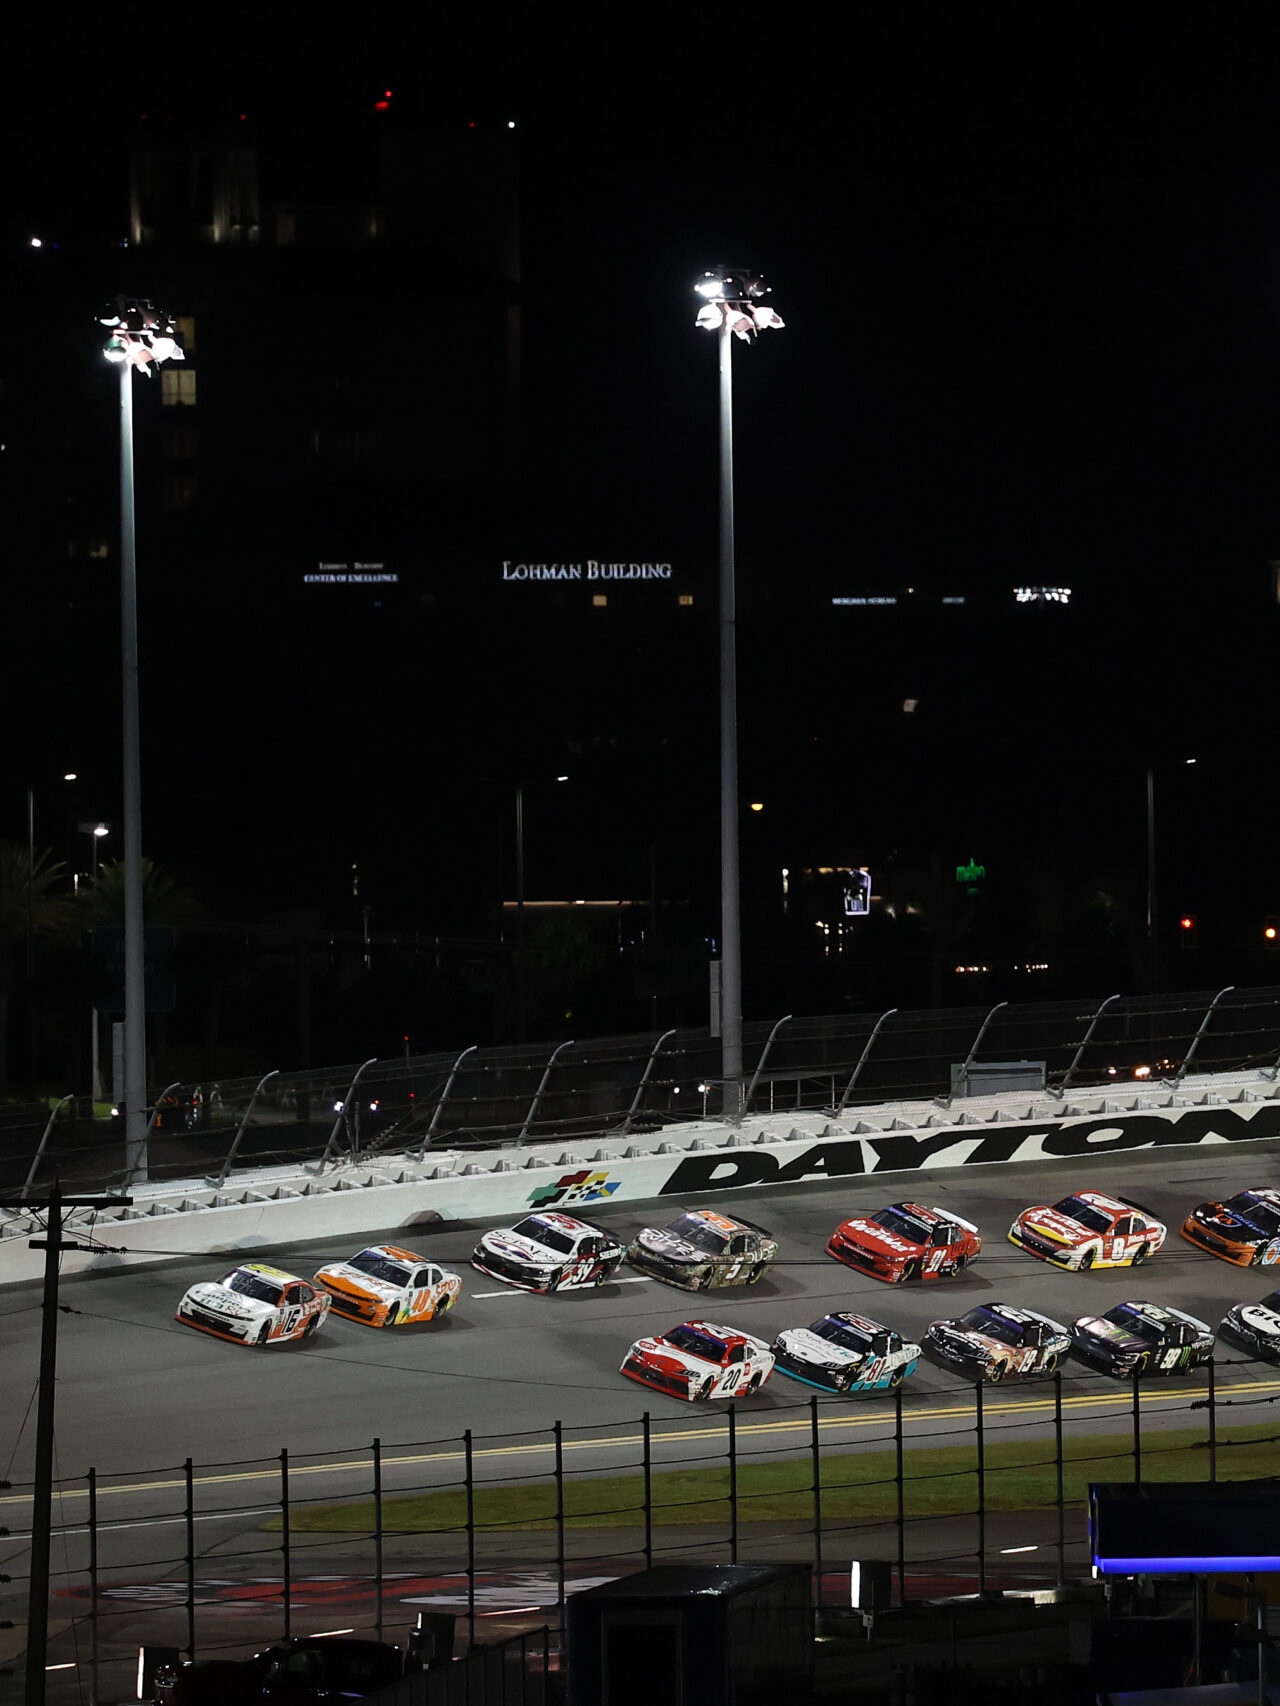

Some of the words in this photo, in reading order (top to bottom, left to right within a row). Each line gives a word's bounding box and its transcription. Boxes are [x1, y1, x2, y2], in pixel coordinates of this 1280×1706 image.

[502, 560, 581, 581] LOHMAN
[587, 560, 672, 580] BUILDING
[698, 1210, 738, 1231] 5
[925, 1249, 947, 1273] 91
[1111, 1238, 1126, 1260] 8
[572, 1256, 595, 1284] 39
[725, 1256, 745, 1280] 5
[281, 1307, 302, 1334] 16
[1017, 1349, 1038, 1373] 19
[1159, 1347, 1183, 1369] 98
[721, 1368, 741, 1391] 20
[865, 1358, 888, 1383] 81
